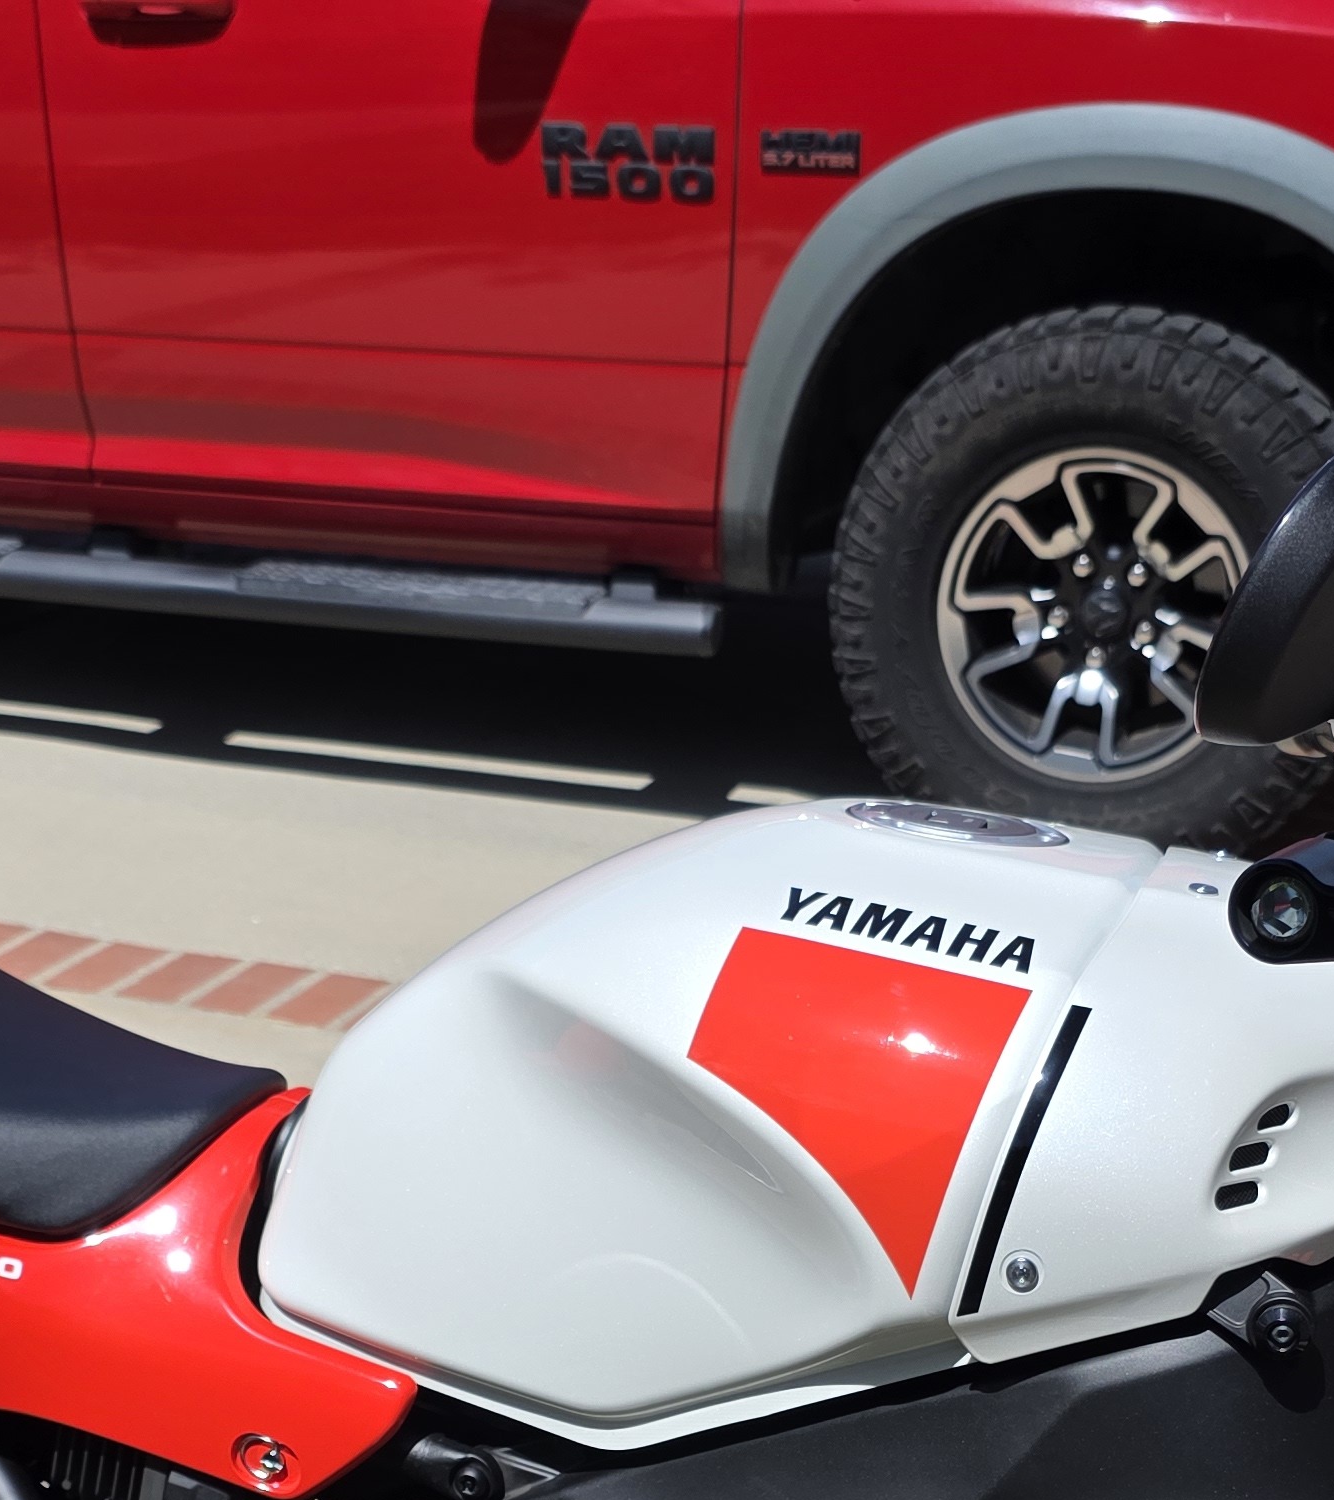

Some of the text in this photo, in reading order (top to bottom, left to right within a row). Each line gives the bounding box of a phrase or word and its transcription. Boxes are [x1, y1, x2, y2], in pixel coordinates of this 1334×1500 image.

[540, 121, 716, 166] RAM
[797, 152, 856, 170] LITER
[541, 160, 716, 206] 1500
[780, 887, 1035, 974] YAMAHA
